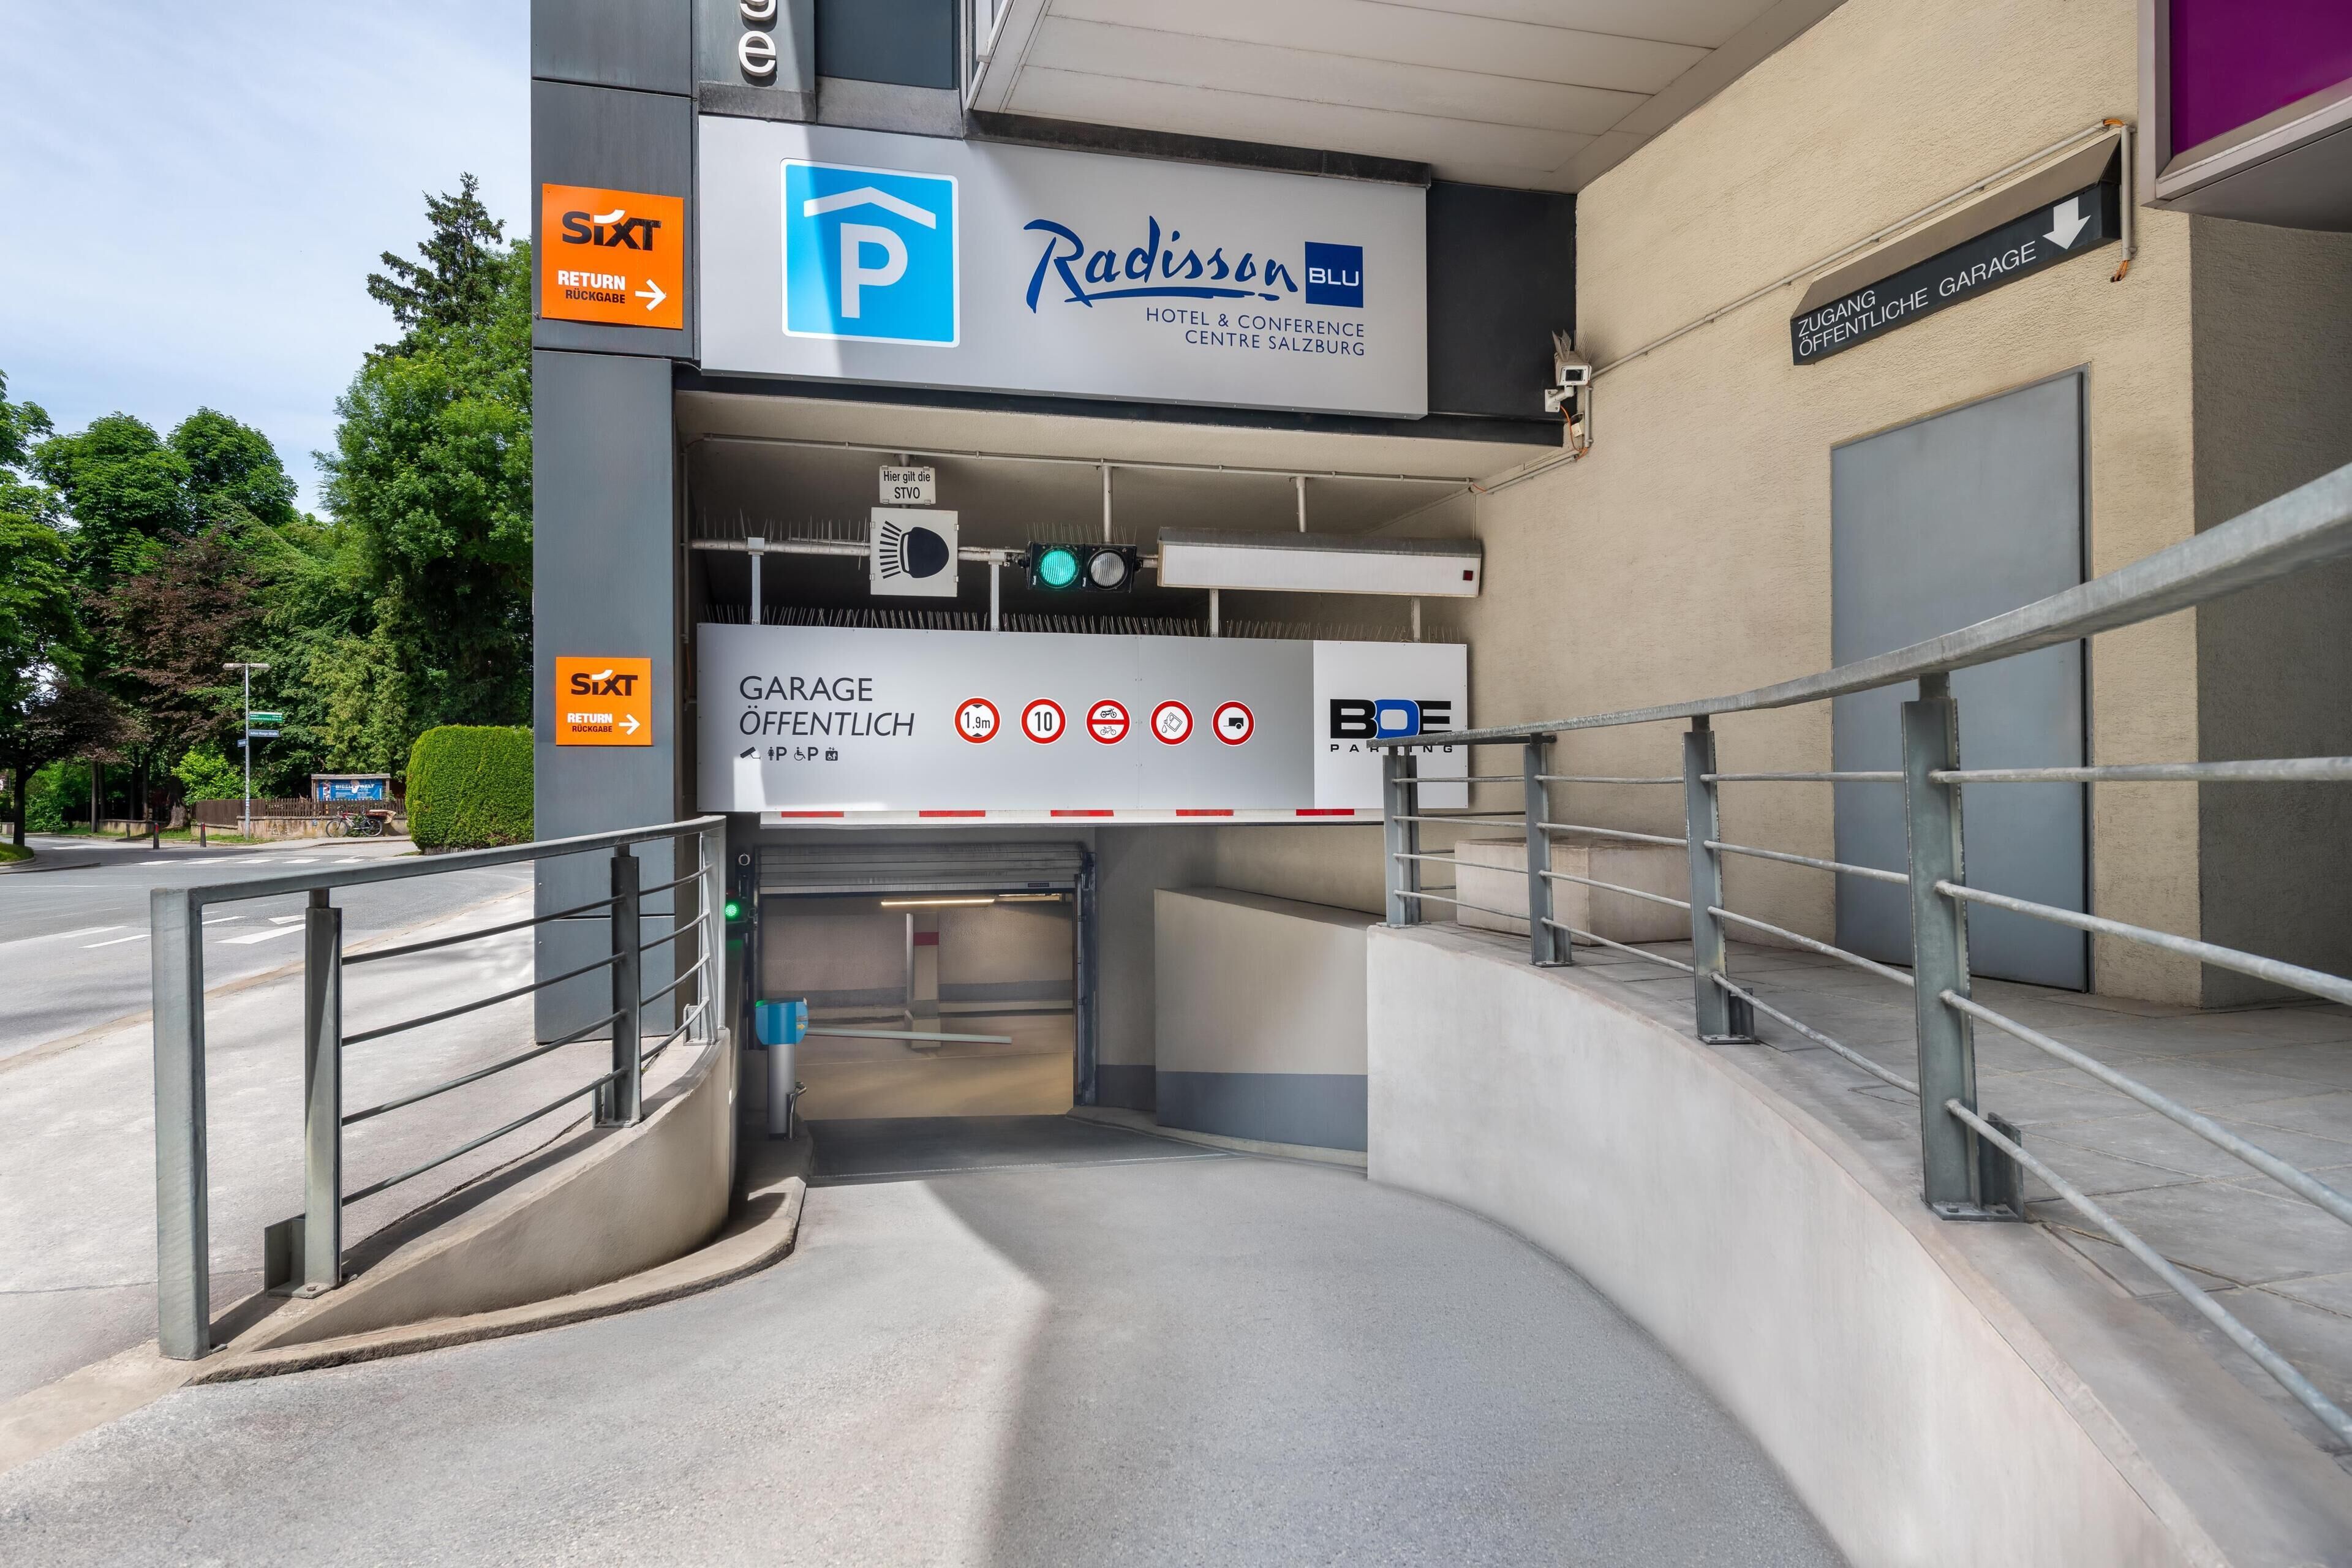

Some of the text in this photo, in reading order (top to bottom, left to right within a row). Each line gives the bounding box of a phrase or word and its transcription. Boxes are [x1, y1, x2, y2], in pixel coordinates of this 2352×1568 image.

[840, 222, 908, 318] P
[1023, 216, 1359, 314] Radisson BLU
[558, 270, 626, 290] RETURN
[565, 288, 626, 304] RÜCKGABE
[1799, 241, 2036, 356] ÖFFENTLICHE GARAGE
[1147, 307, 1365, 337] HOTEL & CONFERENCE
[1798, 290, 1875, 338] ZUGANG
[1185, 330, 1365, 356] CENTRE SALZBURG
[883, 471, 930, 483] Hier gilt die
[894, 487, 921, 499] STVO
[739, 676, 873, 702] GARAGE
[567, 713, 612, 724] RETURN
[572, 724, 612, 733] RÜCKGABE
[739, 706, 915, 736] ÖFFENTLICH
[1035, 712, 1053, 731] 10
[1330, 699, 1452, 739] BOE
[1330, 743, 1453, 753] PARING
